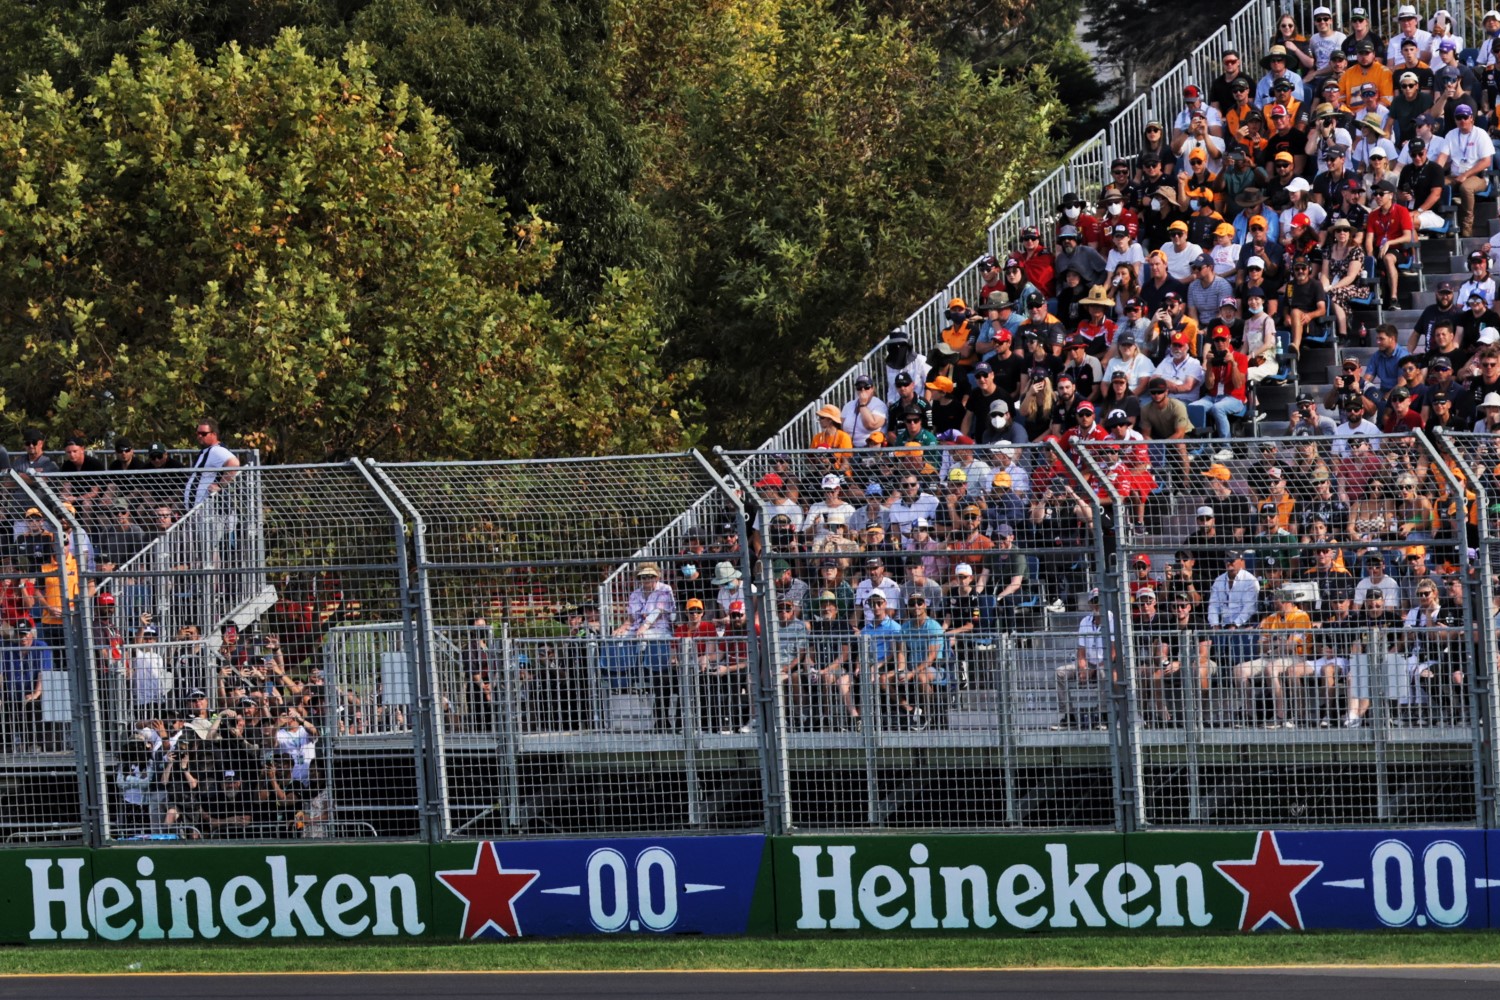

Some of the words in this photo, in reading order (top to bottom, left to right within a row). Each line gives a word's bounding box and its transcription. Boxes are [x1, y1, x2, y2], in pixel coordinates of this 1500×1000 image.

[25, 855, 426, 941] Heineken
[586, 846, 678, 932] 0.0
[792, 843, 1213, 930] Heineken
[1370, 838, 1468, 927] 0.0
